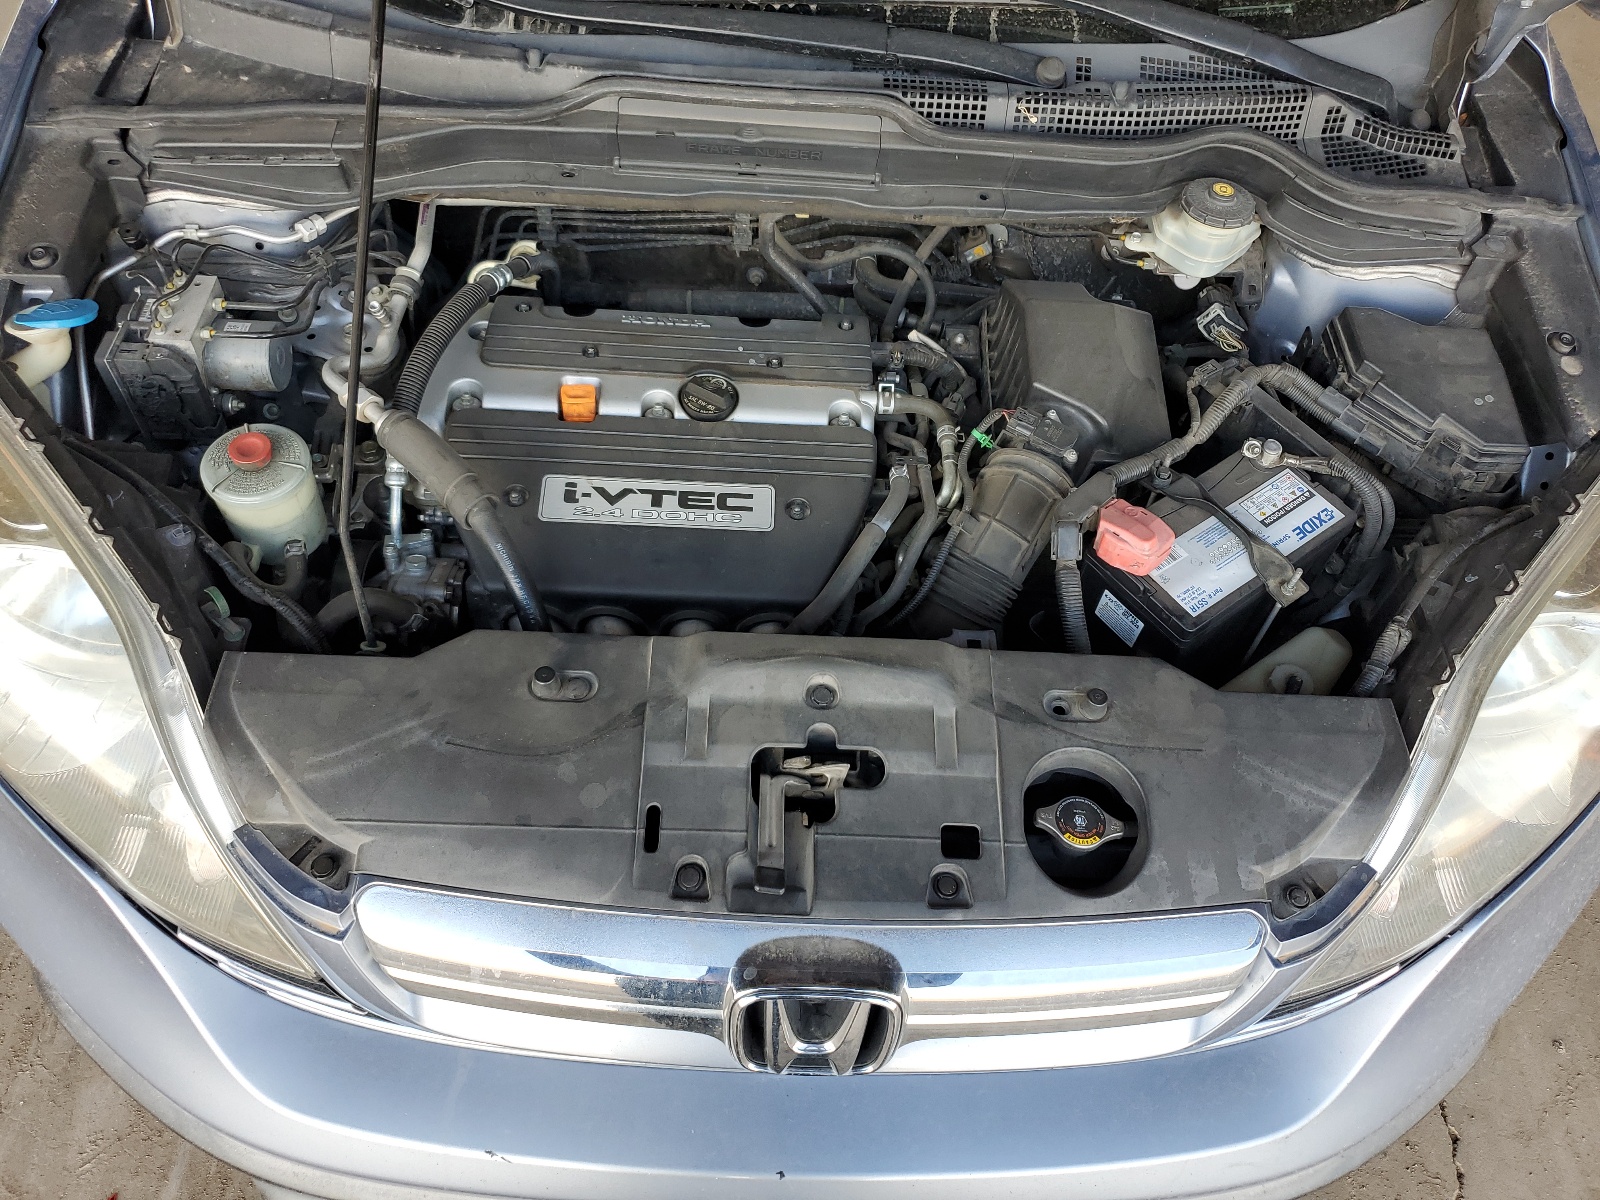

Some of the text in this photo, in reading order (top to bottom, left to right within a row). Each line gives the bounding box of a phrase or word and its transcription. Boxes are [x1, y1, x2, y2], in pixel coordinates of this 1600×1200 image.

[686, 142, 823, 161] FRAME NUMBER
[621, 315, 711, 328] HONDA
[563, 481, 754, 512] i-VTEC
[1284, 495, 1306, 510] DANGER
[573, 505, 743, 523] 2.4 DOHC
[1291, 507, 1335, 541] EXIDE
[495, 542, 515, 572] NICHIRIN
[1211, 585, 1224, 597] Part
[1189, 597, 1209, 613] S51R
